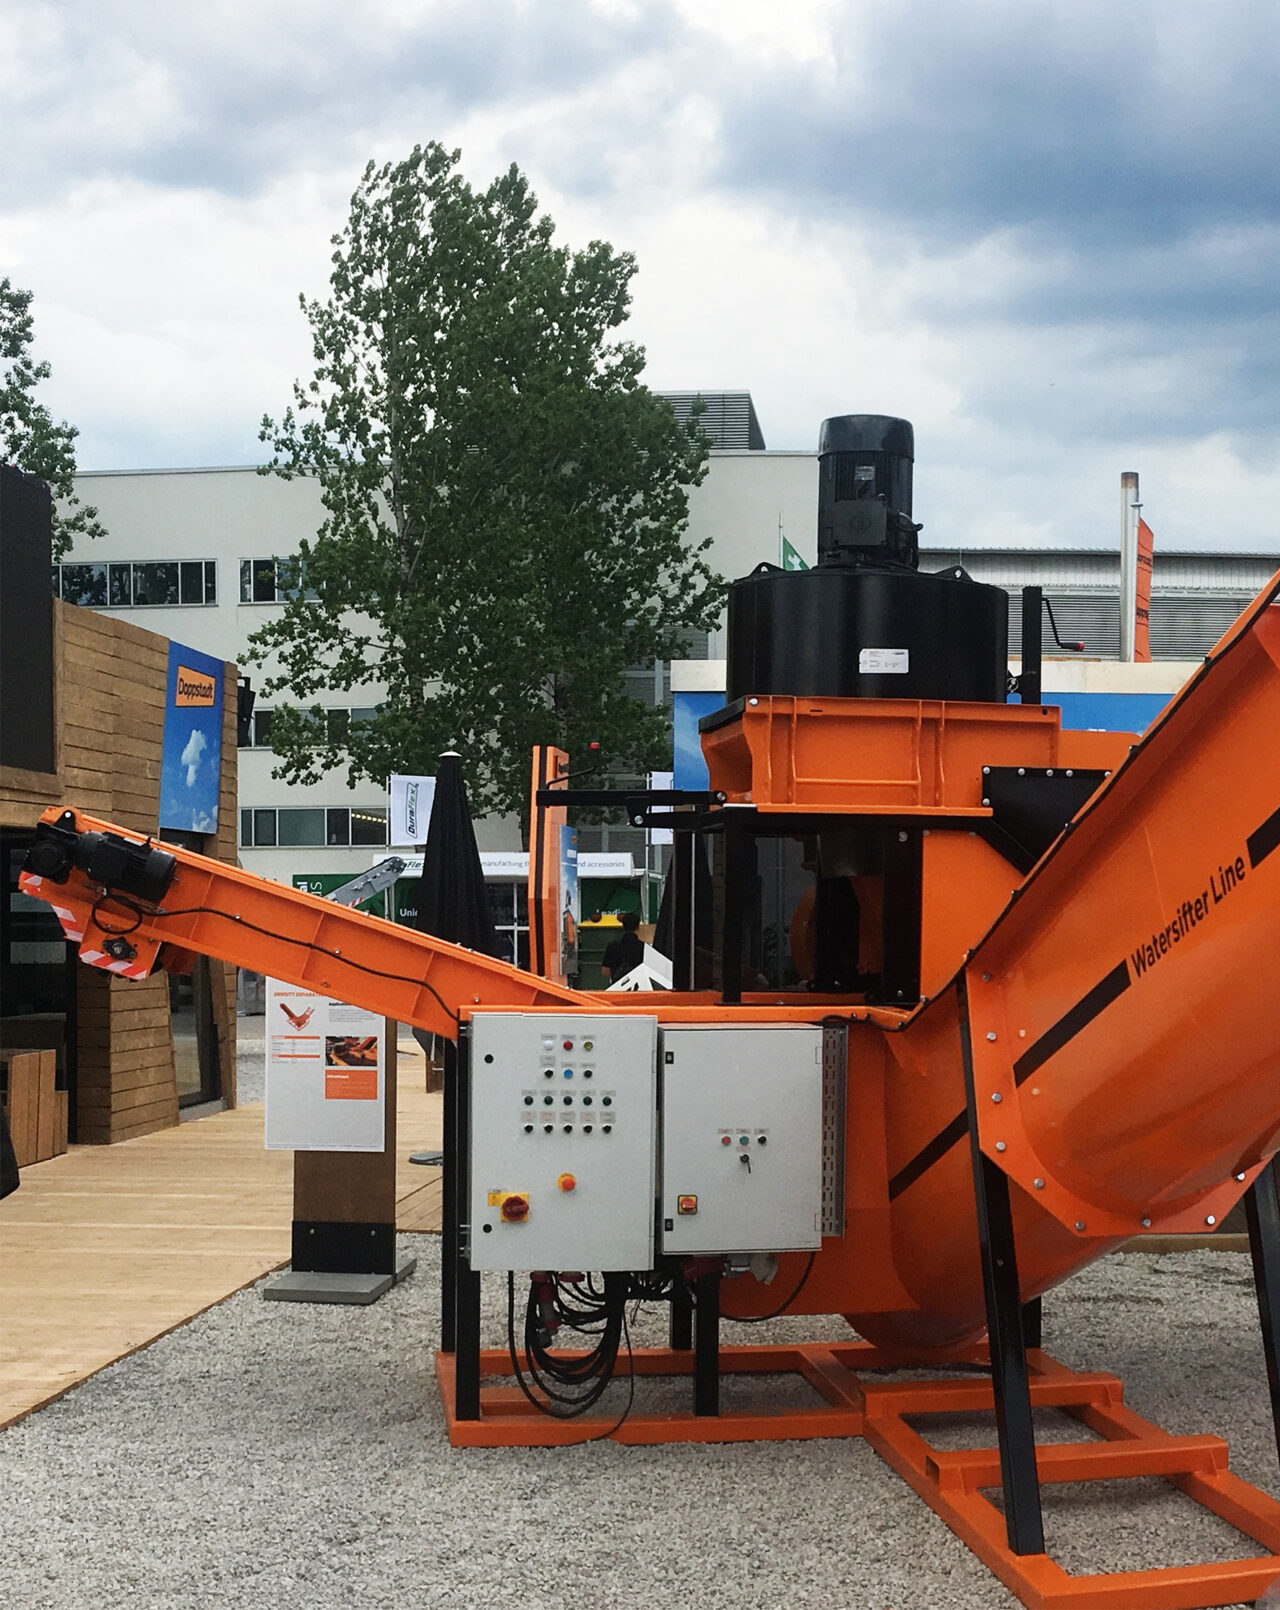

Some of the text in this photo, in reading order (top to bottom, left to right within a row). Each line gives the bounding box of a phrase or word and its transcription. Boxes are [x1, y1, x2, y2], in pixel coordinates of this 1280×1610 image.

[178, 678, 213, 700] Doppstadt
[1131, 856, 1246, 978] Watersifter Line
